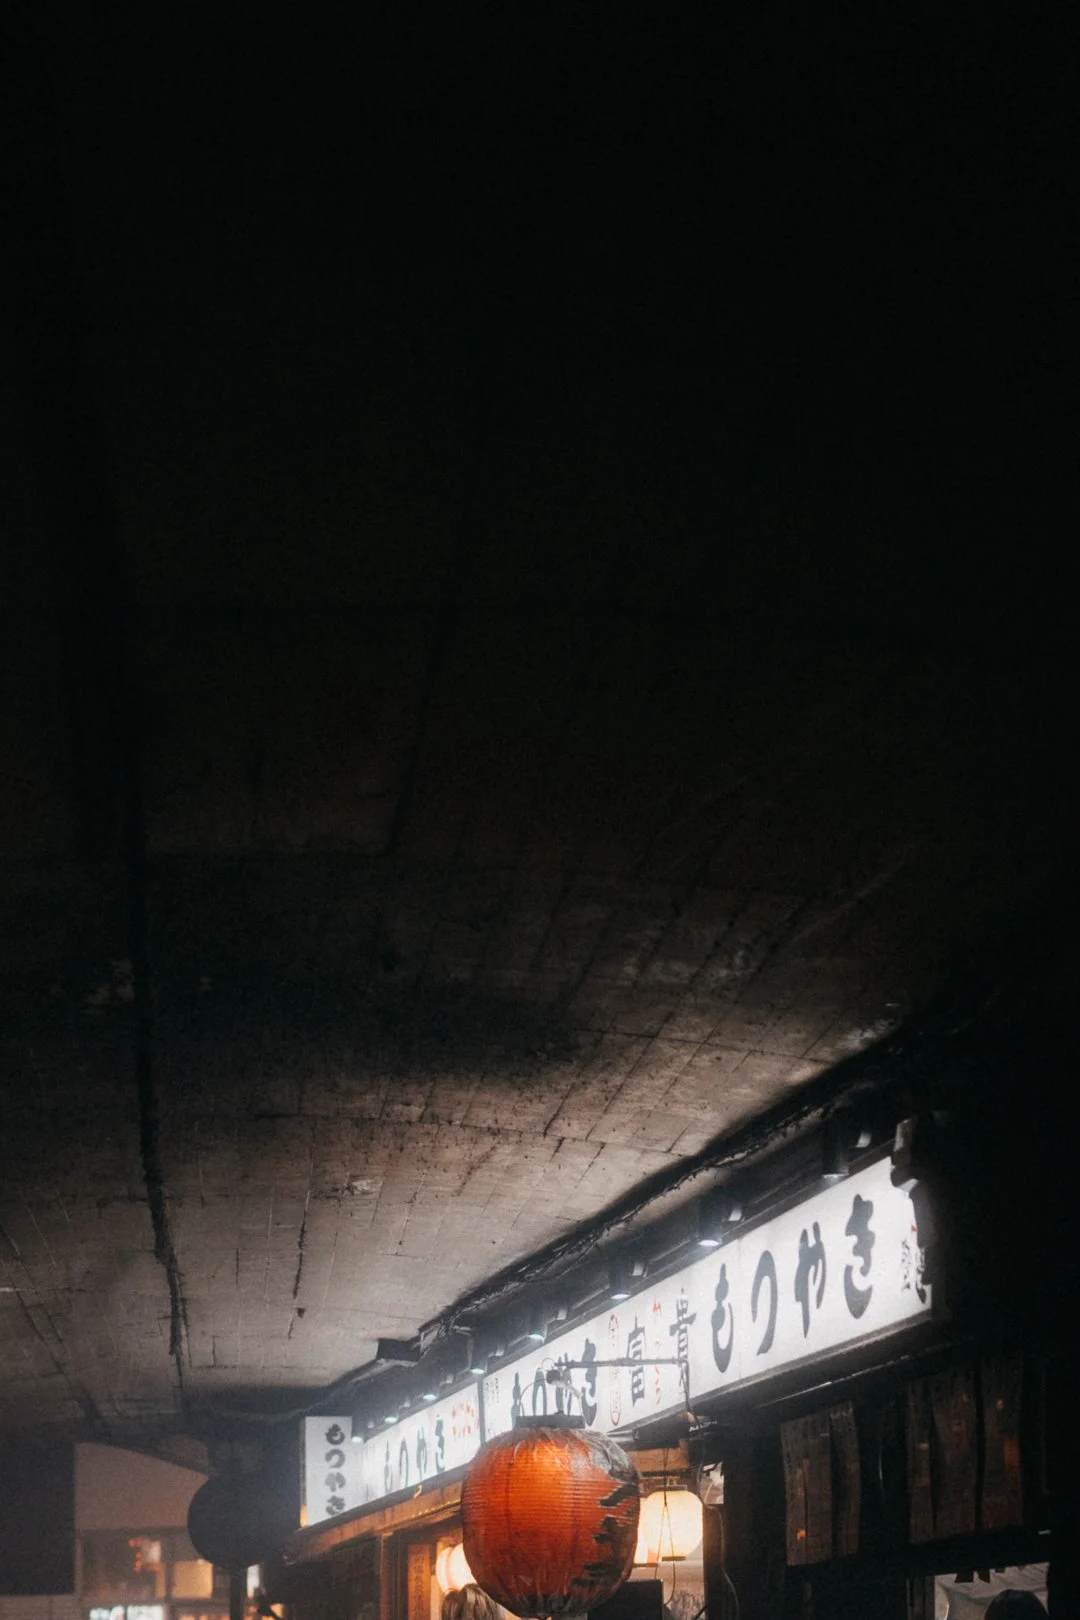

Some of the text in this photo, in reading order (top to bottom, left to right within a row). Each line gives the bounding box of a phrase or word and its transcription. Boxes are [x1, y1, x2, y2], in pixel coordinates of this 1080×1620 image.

[711, 1192, 876, 1375] もつやき
[324, 1423, 346, 1516] もつやき
[383, 1416, 445, 1494] もつやき
